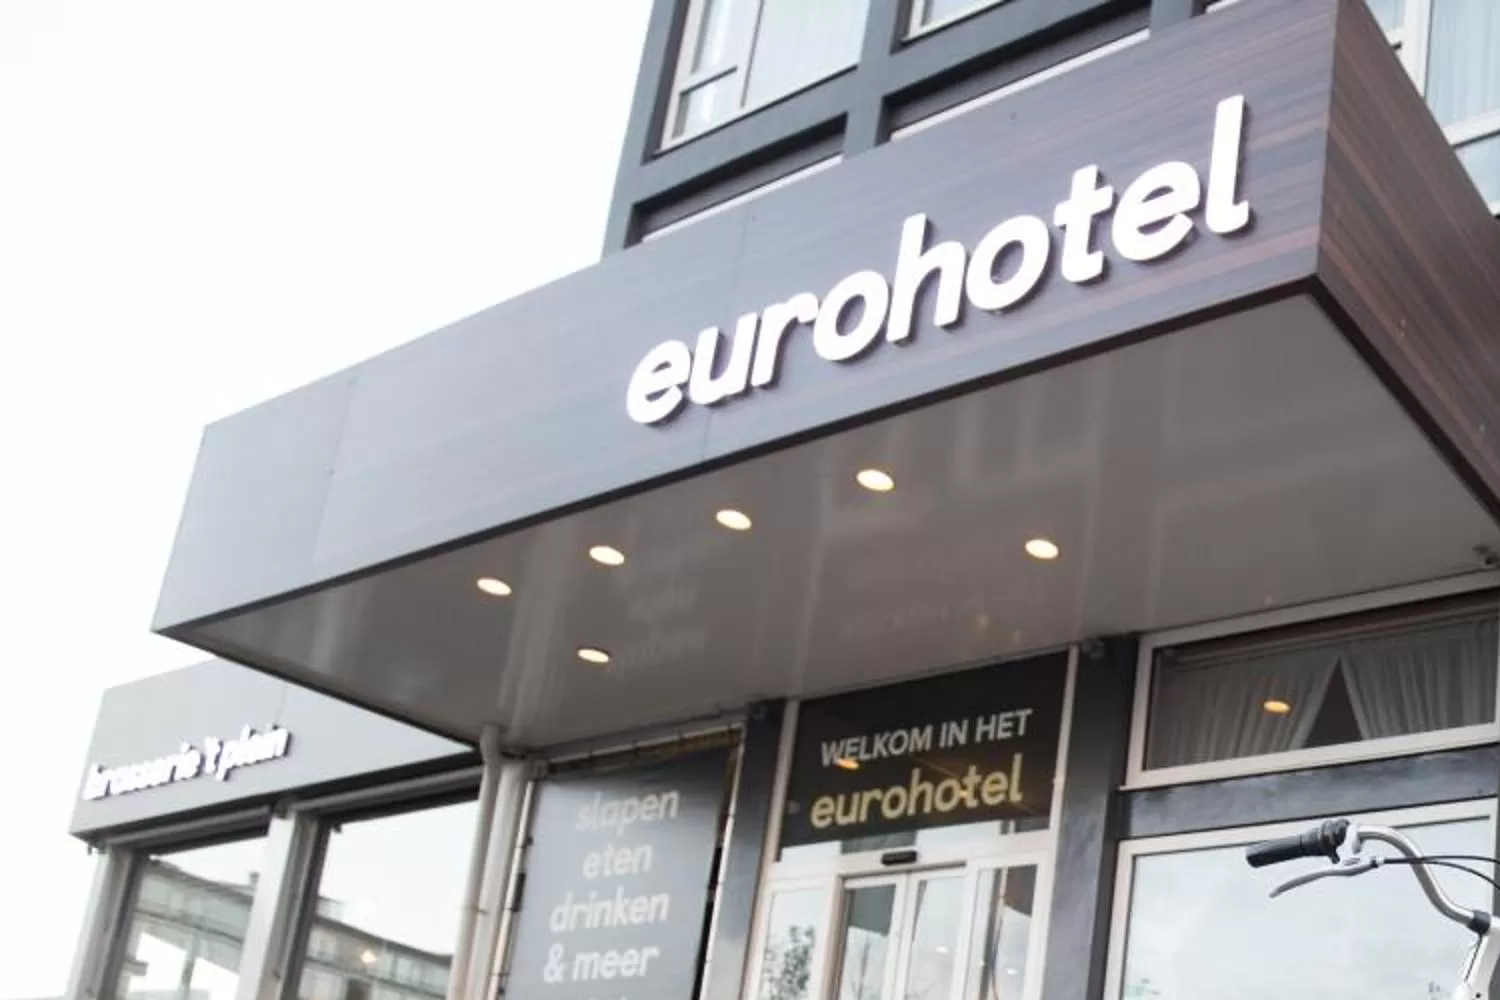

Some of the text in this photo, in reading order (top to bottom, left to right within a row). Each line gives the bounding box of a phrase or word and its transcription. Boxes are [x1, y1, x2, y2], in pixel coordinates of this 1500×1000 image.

[626, 94, 1253, 427] eurohotel
[820, 708, 1033, 768] WELKOM IN HET
[575, 789, 681, 836] slapen
[809, 752, 1024, 829] eurohotel
[582, 843, 652, 880] eten
[549, 885, 670, 933] drinken
[543, 943, 660, 983] & meer
